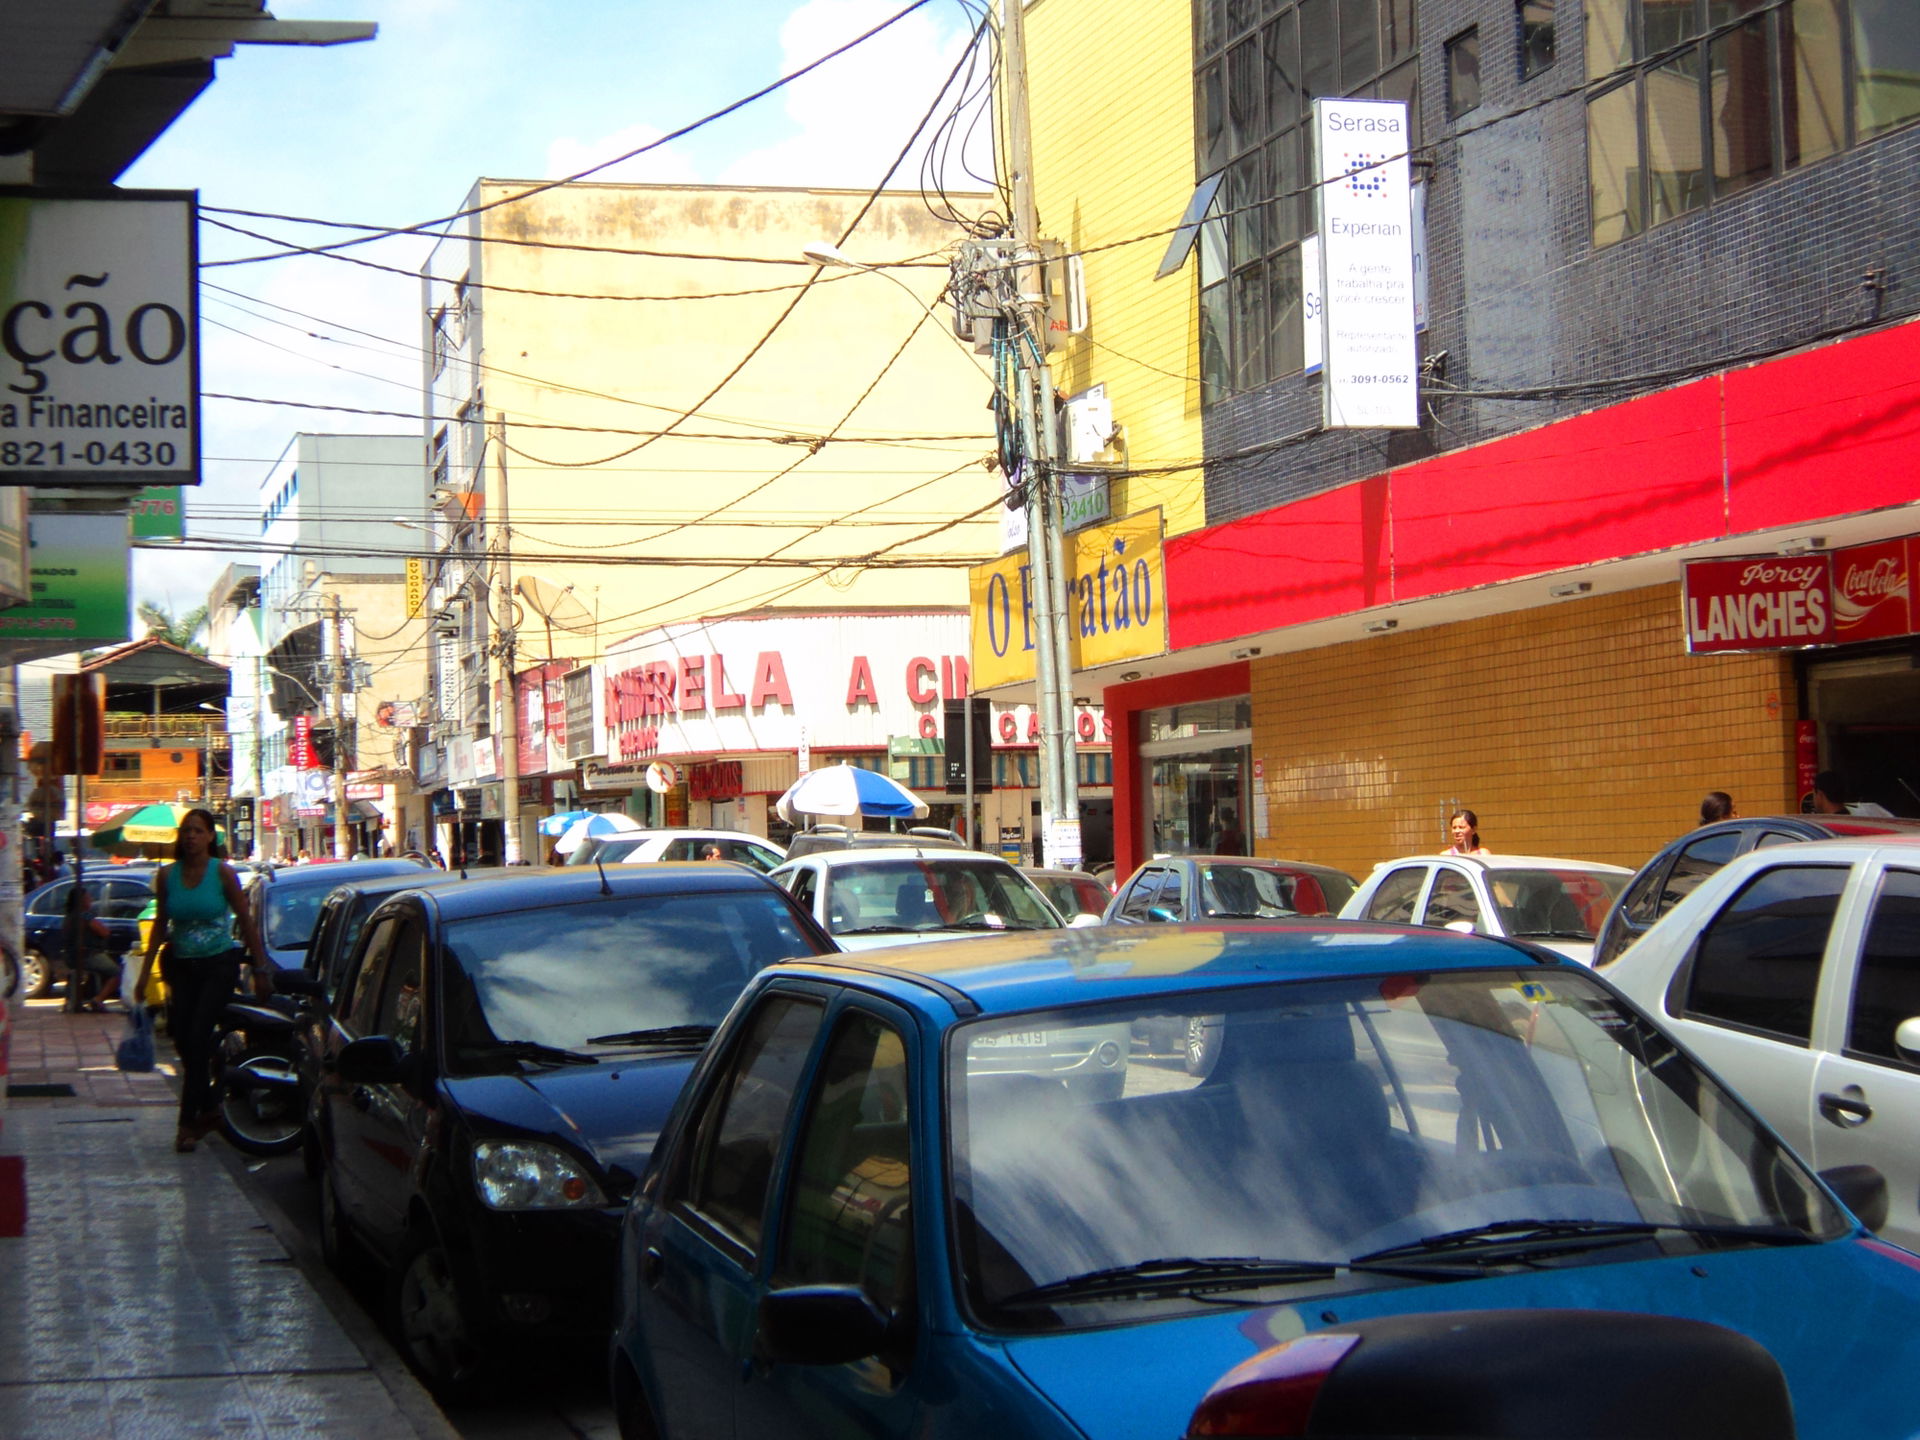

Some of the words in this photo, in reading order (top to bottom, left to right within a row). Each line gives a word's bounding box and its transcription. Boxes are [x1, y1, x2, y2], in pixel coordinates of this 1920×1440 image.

[1328, 112, 1400, 133] Serasa
[1332, 217, 1402, 237] Experian
[2, 272, 187, 394] ção
[1351, 375, 1409, 385] 3091-0562
[29, 397, 187, 430] Financeira
[2, 441, 176, 467] 821-0430
[1740, 562, 1823, 590] Percy
[988, 572, 1011, 658] O
[1689, 588, 1826, 643] LANCHES
[846, 656, 878, 704] A
